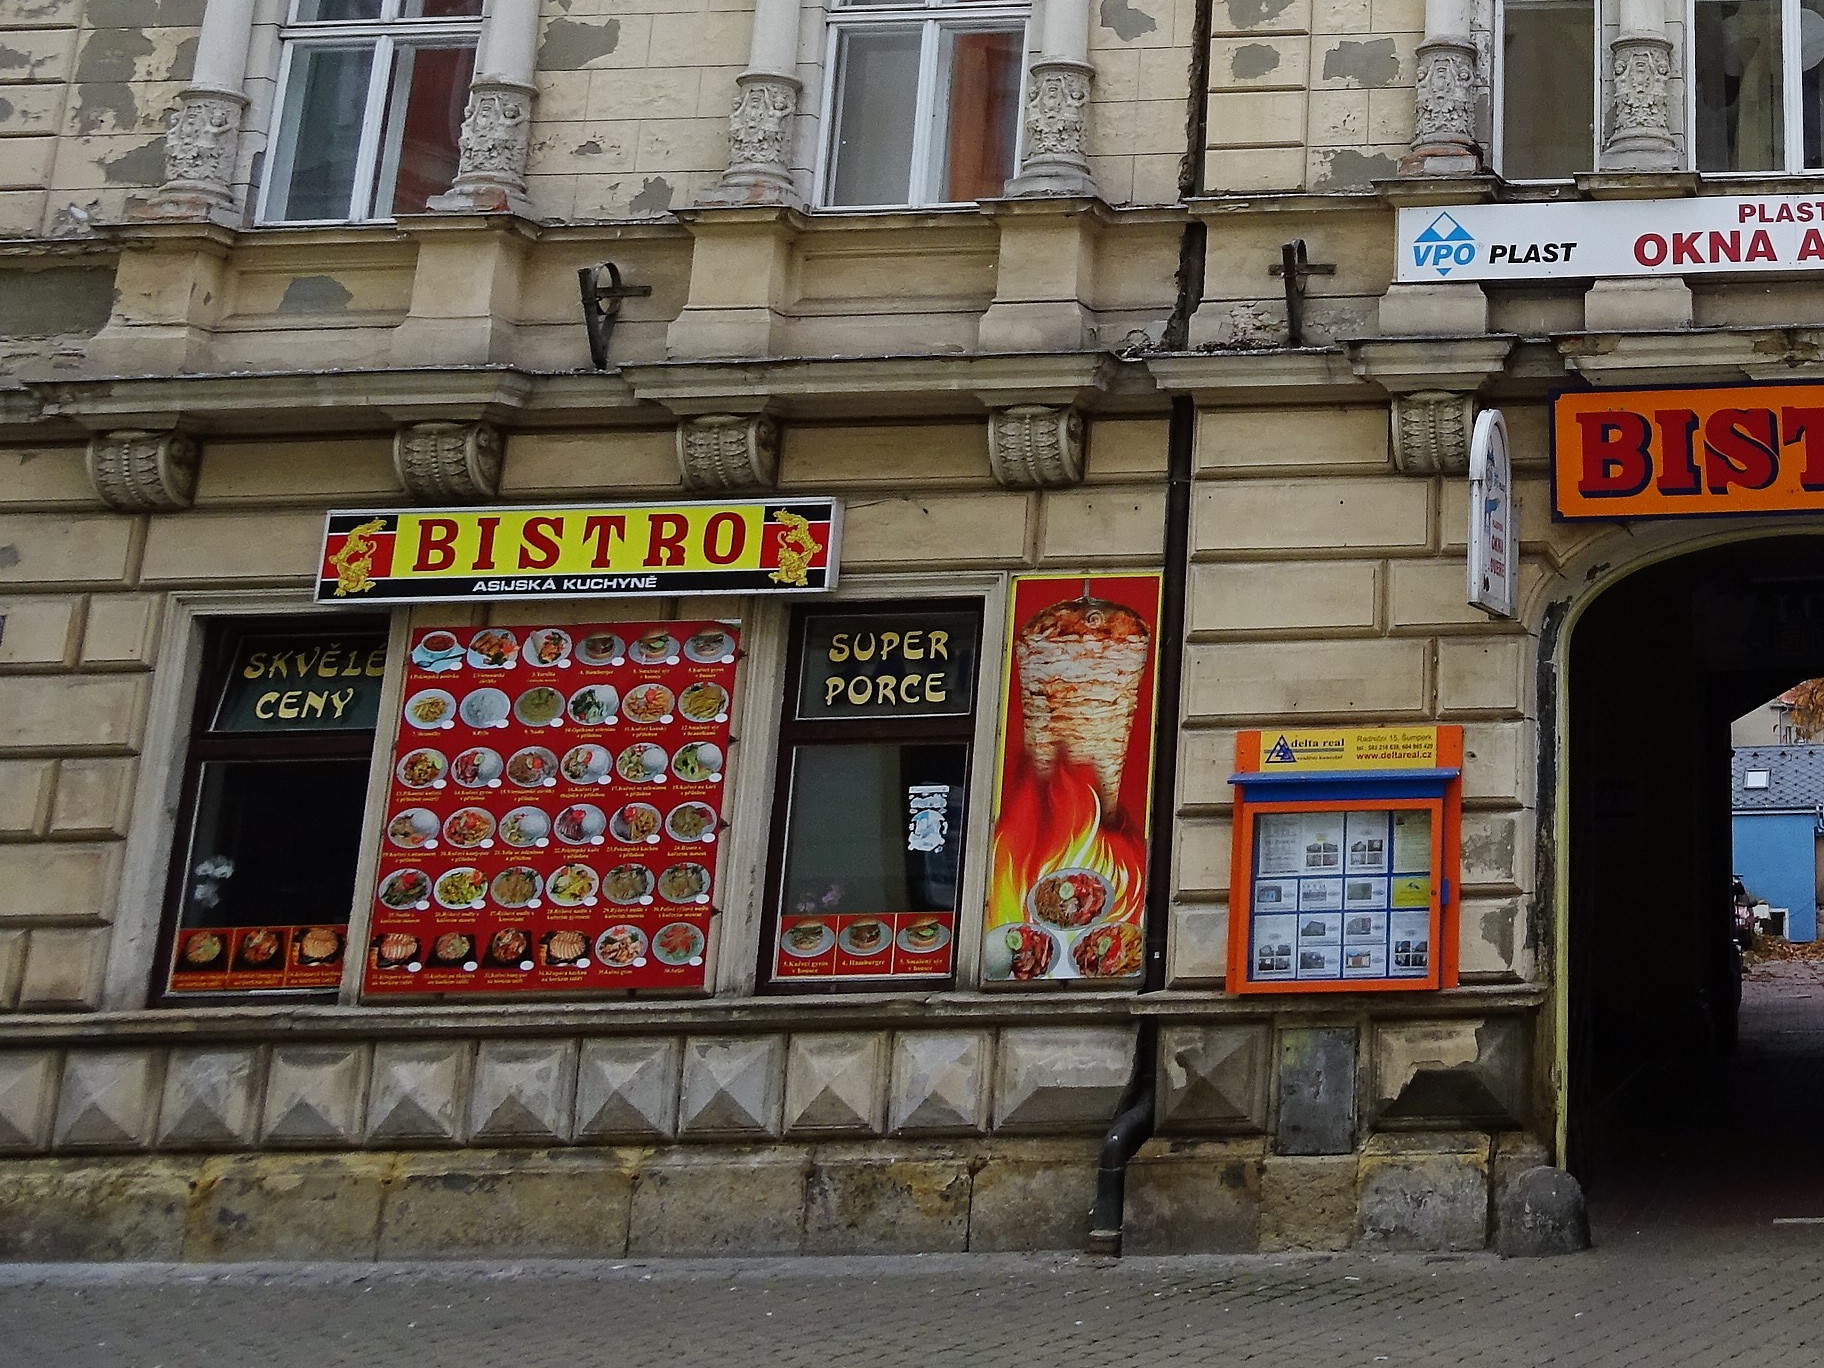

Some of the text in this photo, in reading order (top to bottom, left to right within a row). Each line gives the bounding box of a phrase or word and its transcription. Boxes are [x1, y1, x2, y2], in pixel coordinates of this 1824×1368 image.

[1413, 243, 1476, 267] VPO
[1489, 243, 1578, 264] PLAST
[1633, 230, 1778, 267] OKNA
[412, 511, 746, 573] BISTRO
[472, 575, 657, 592] ASIJSKÁ KUCHYNĚ
[244, 642, 388, 679] SKVĚLÉ
[829, 630, 949, 662] SUPER
[255, 688, 354, 720] CENY
[825, 672, 946, 706] PORCE
[1291, 737, 1344, 748] delta real
[1356, 750, 1432, 760] www.deltareal.cz
